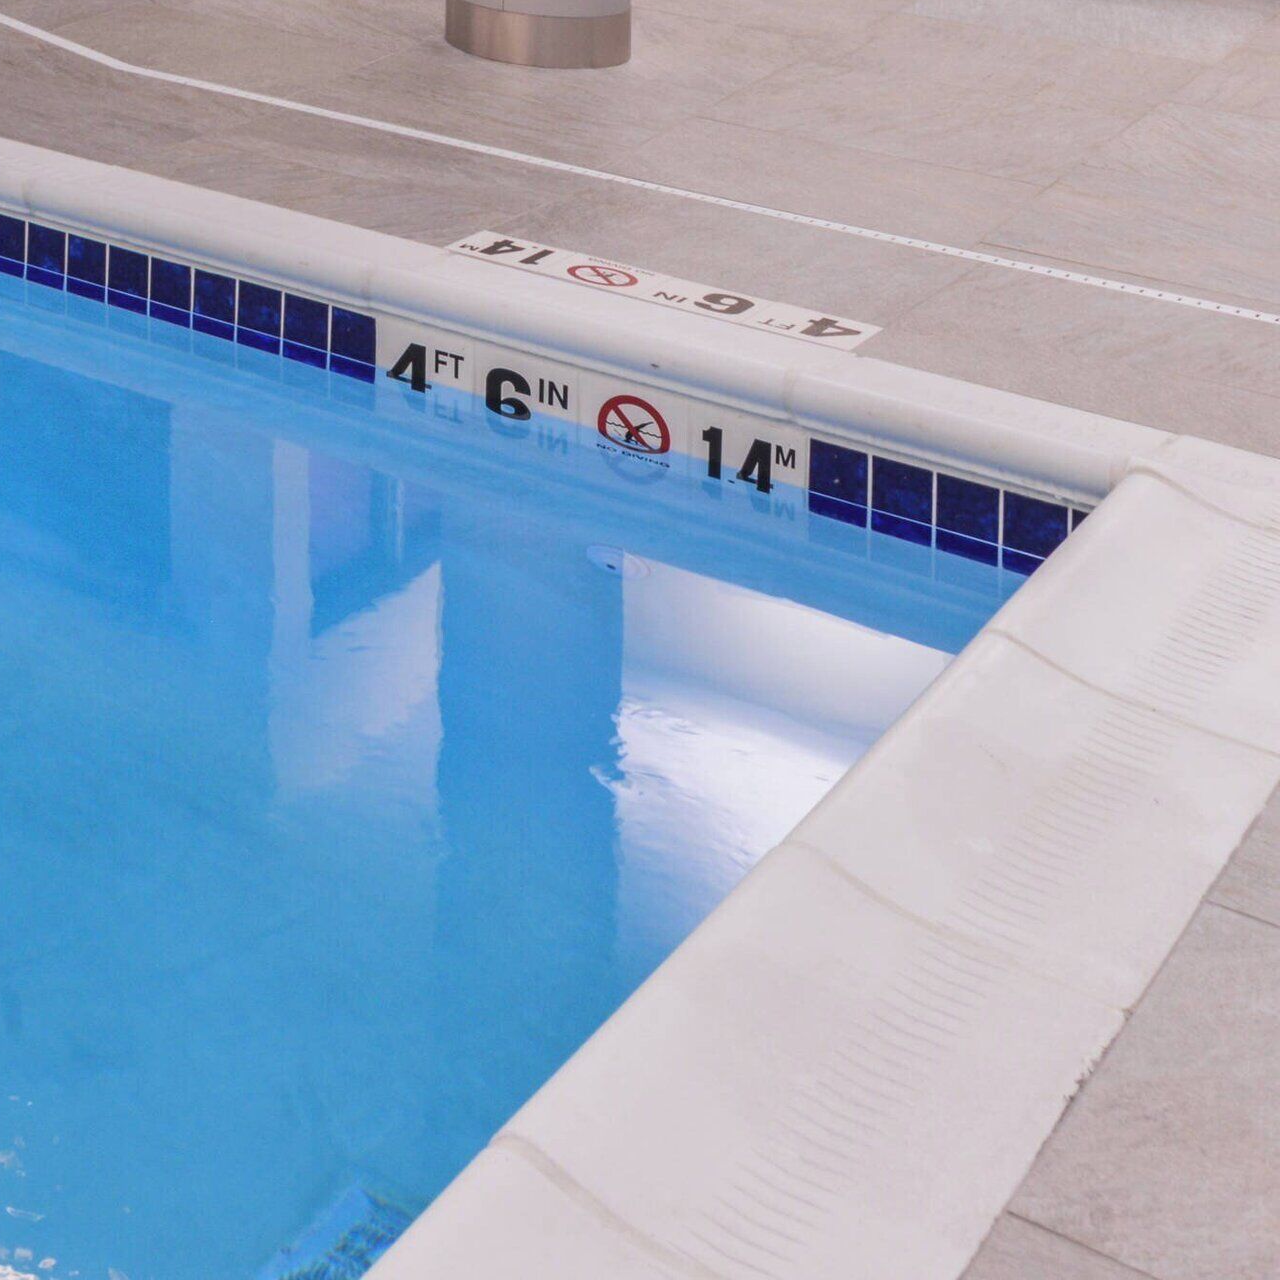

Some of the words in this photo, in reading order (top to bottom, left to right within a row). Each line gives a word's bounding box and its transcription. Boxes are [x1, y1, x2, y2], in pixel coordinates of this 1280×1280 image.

[653, 291, 687, 303] IN
[694, 293, 755, 314] 6
[757, 318, 795, 330] FT
[800, 317, 862, 337] 4
[386, 343, 432, 393] 4
[435, 349, 465, 379] FT
[485, 368, 532, 420] 6
[539, 378, 569, 410] IN
[776, 445, 796, 469] M
[596, 443, 617, 452] NO
[622, 451, 670, 468] DIVING
